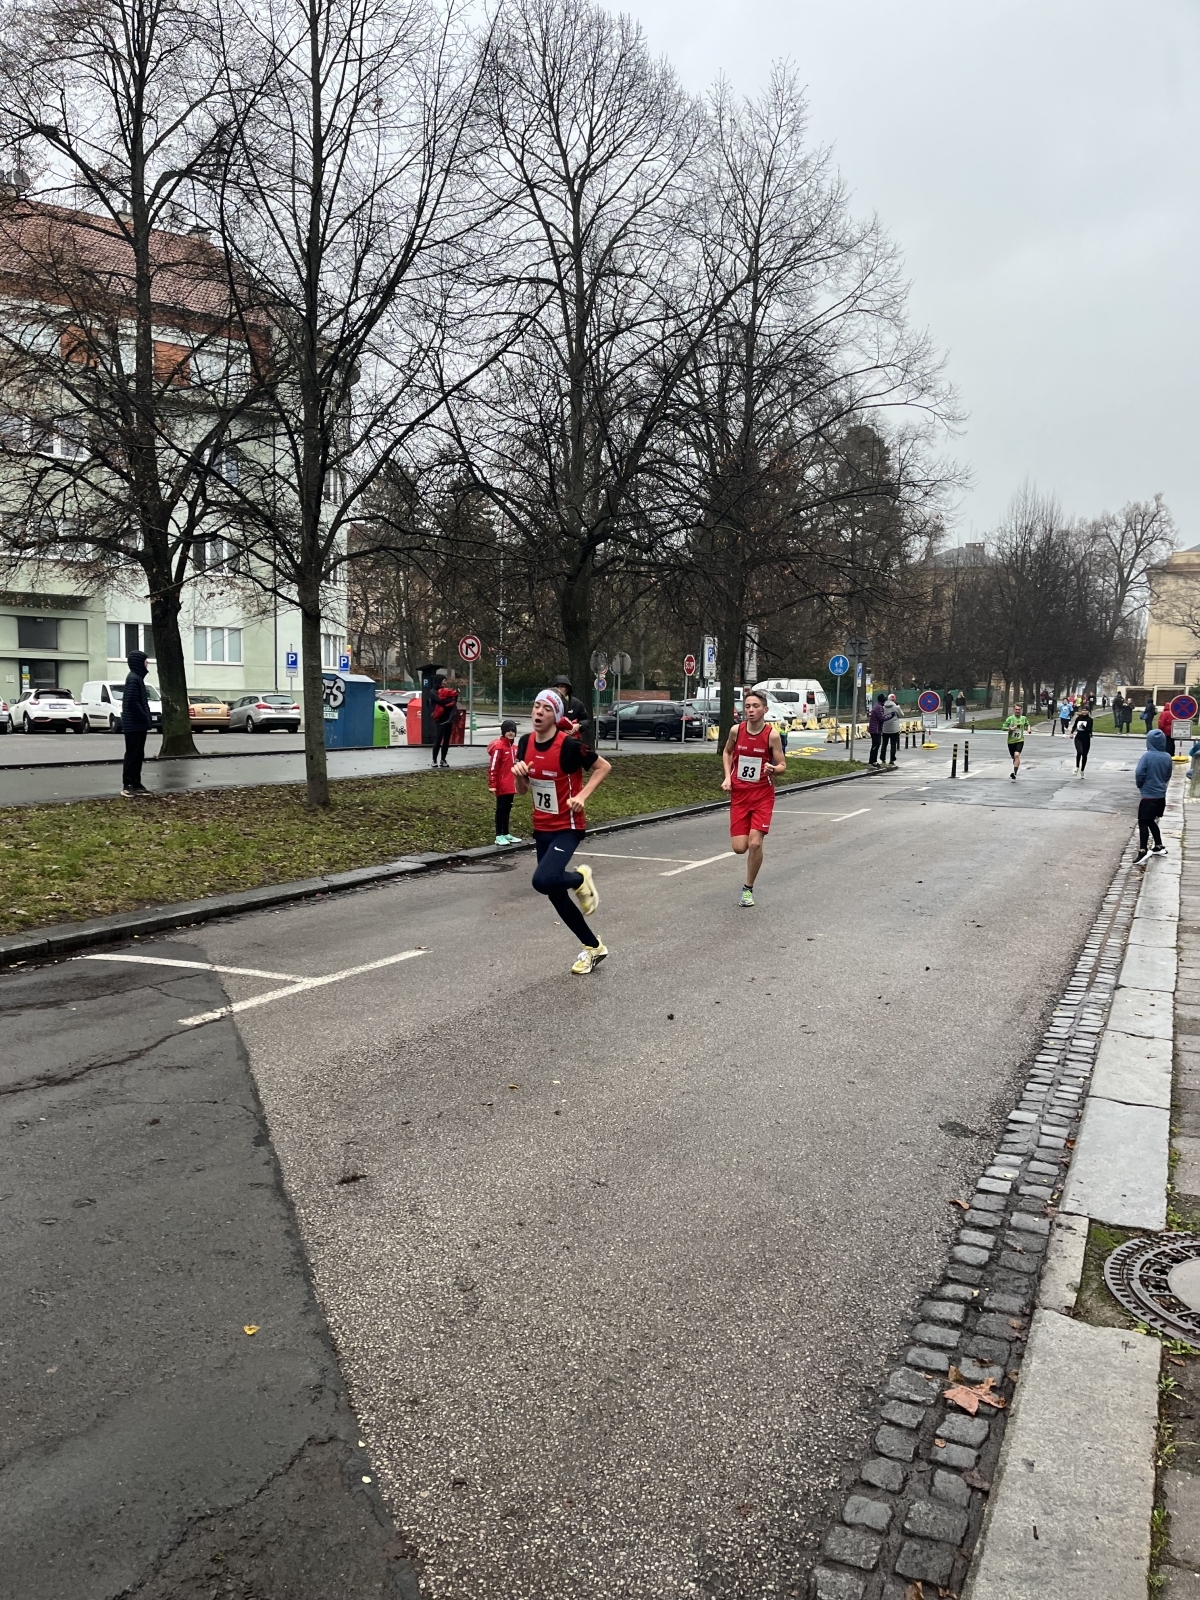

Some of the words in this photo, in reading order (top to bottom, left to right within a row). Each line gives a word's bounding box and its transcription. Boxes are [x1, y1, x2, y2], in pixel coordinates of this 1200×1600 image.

[288, 654, 296, 665] P
[340, 656, 347, 667] P
[322, 678, 346, 708] FS
[741, 766, 756, 778] 83
[536, 791, 551, 809] 78
